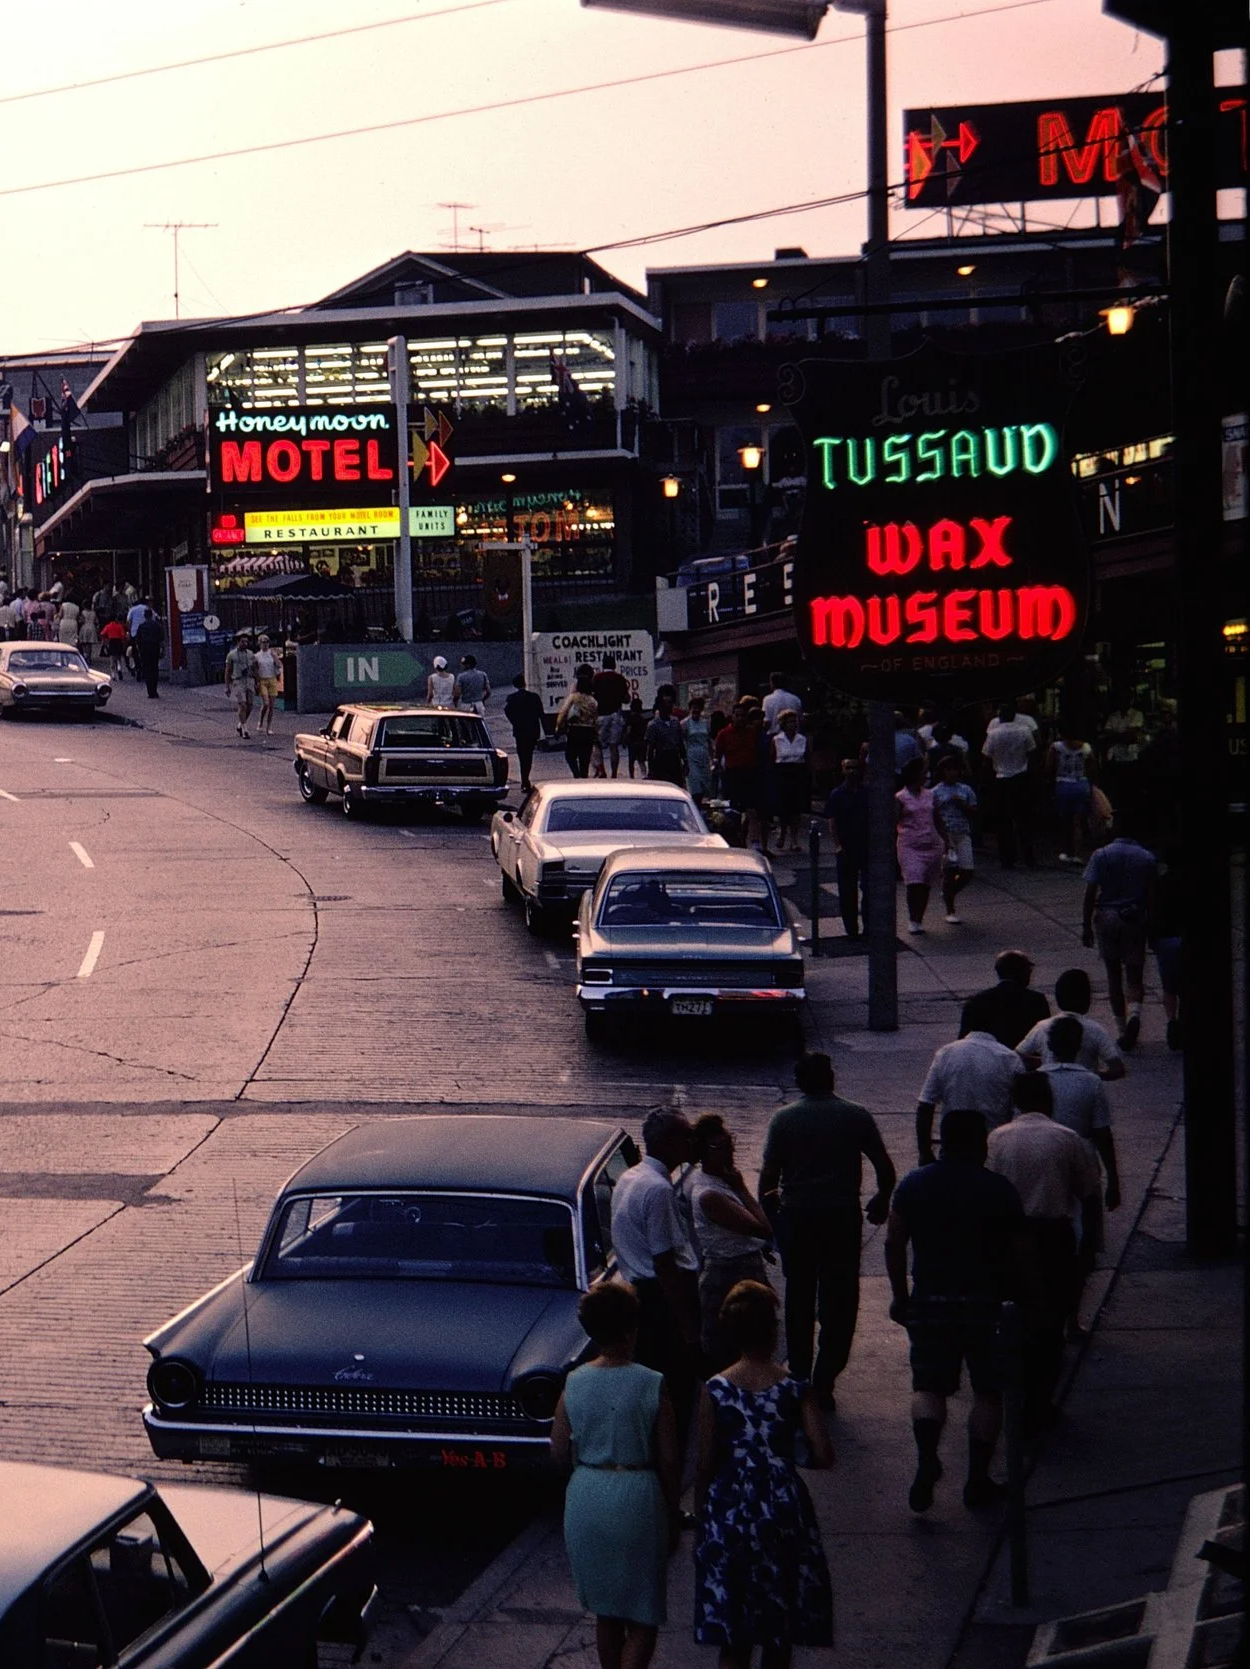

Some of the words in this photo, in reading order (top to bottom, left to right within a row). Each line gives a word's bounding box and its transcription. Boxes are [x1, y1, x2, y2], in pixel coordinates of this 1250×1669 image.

[871, 375, 981, 427] Louis
[215, 410, 390, 436] Honeymoon
[221, 439, 393, 482] MOTEL
[811, 420, 1060, 491] TUSSAUD
[251, 514, 262, 524] SEE
[266, 514, 278, 523] THE
[283, 513, 302, 523] FALLS
[306, 513, 325, 521] FROM
[329, 512, 346, 521] YOUR
[350, 511, 371, 520] MOTEL
[374, 510, 393, 519] ROOM
[416, 510, 448, 519] FAMILY
[264, 525, 379, 539] RESTAURANT
[418, 522, 446, 531] UNITS
[864, 515, 1015, 578] WAX
[809, 583, 1078, 649] MUSEUM
[552, 634, 631, 649] COACHLIGHT
[575, 650, 643, 663] RESTAURANT
[881, 658, 901, 673] OF
[912, 653, 1000, 671] ENGLAND
[346, 657, 380, 682] IN
[621, 666, 648, 677] PRICES
